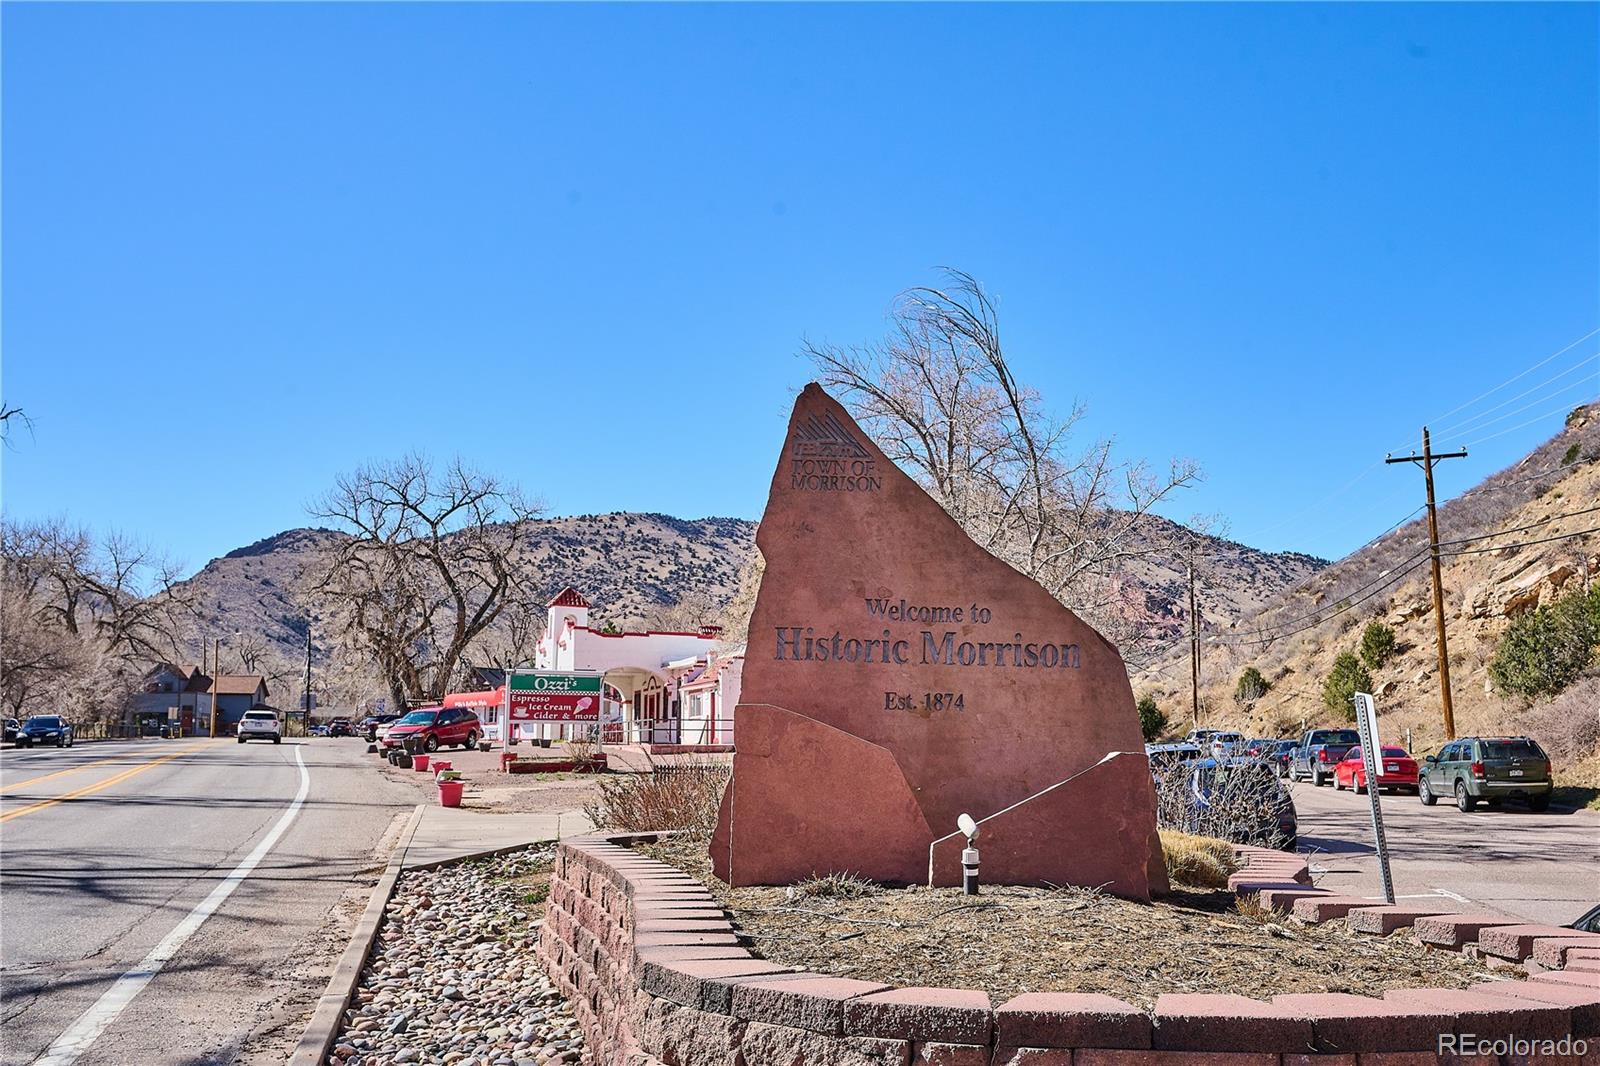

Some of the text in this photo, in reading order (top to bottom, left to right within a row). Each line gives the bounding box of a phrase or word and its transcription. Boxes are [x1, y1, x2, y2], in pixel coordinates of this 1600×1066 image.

[791, 459, 875, 476] TOWN OF
[791, 475, 882, 492] MORRISON
[865, 598, 992, 624] Welcome to
[773, 626, 1082, 669] Historic Morrison
[534, 676, 577, 690] Ozzi's
[511, 694, 550, 704] Espresso
[543, 703, 572, 711] Cream
[884, 691, 965, 712] Est. 1874
[533, 711, 558, 720] Cider
[562, 712, 570, 720] &
